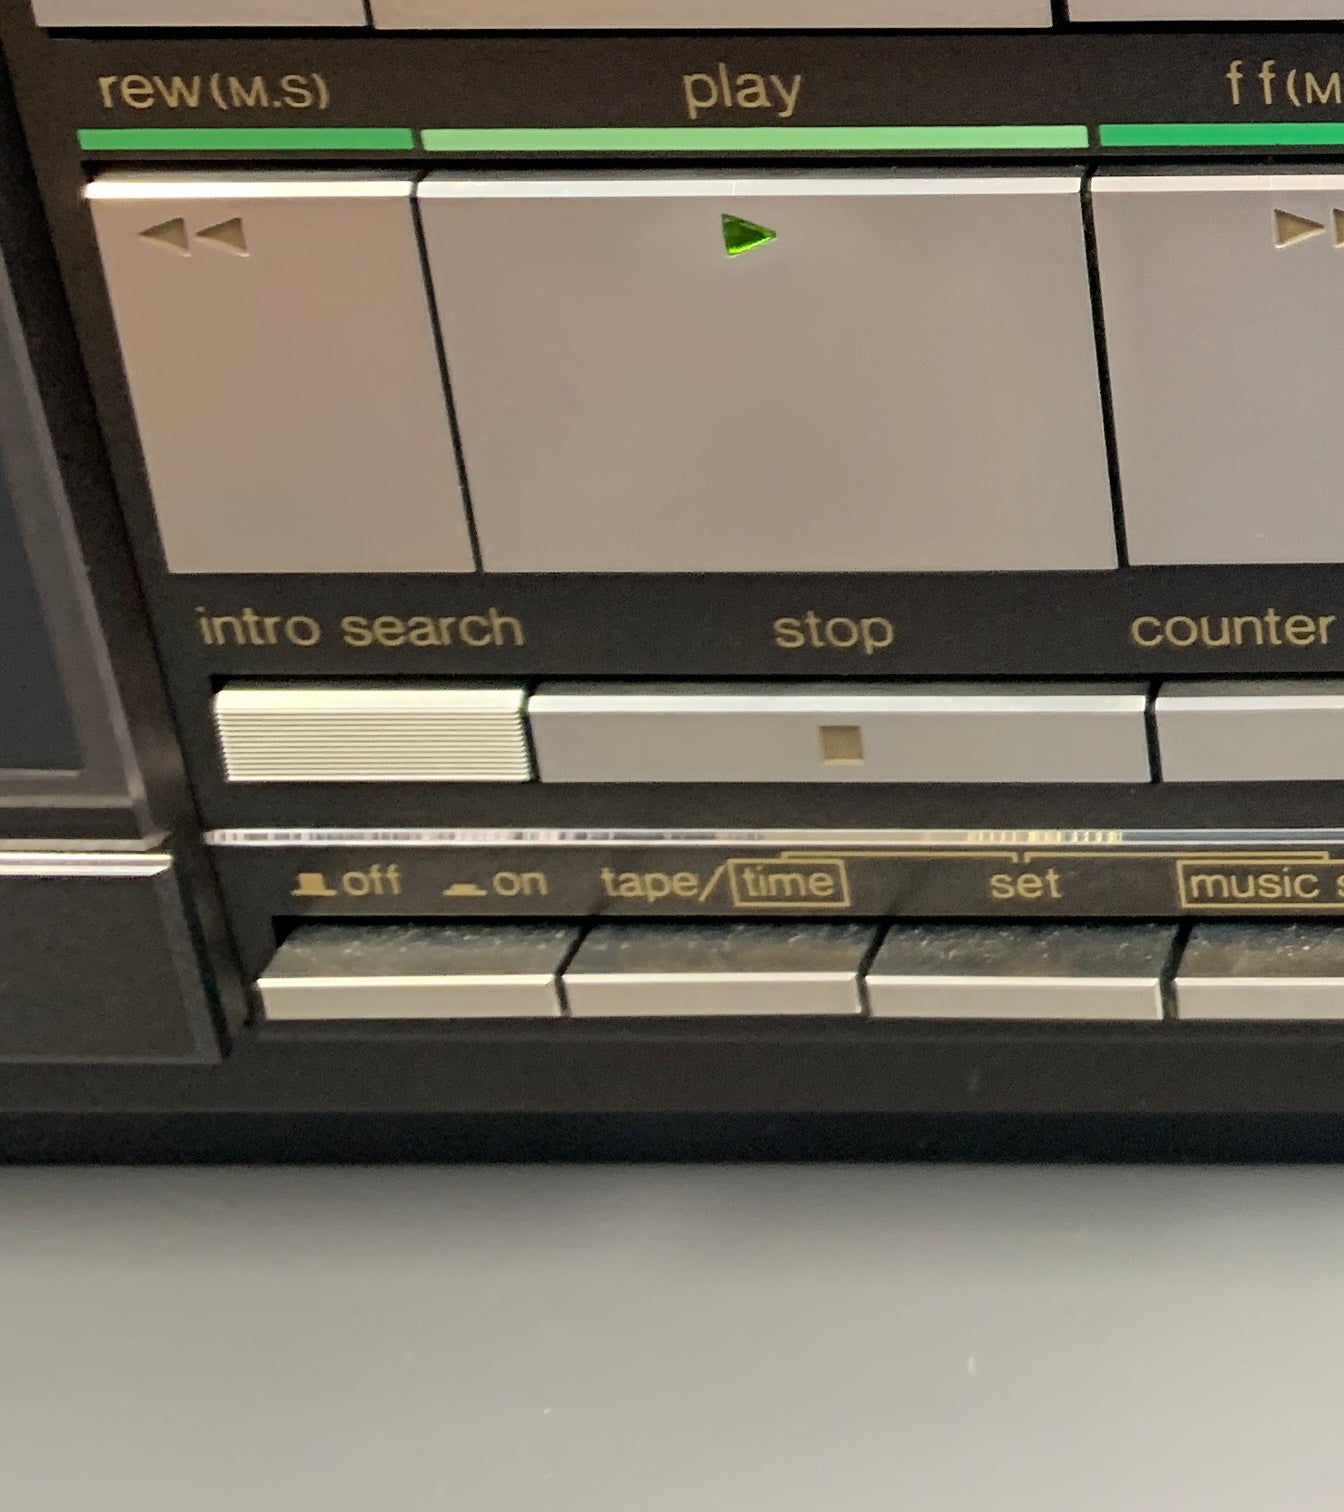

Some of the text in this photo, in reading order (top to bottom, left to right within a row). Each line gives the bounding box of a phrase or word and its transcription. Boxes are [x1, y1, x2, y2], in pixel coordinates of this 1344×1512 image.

[682, 62, 802, 120] play
[196, 607, 525, 647] intro search
[773, 610, 895, 656] stop
[1130, 608, 1338, 649] counter
[342, 864, 401, 897] off
[492, 871, 549, 897] on
[989, 865, 1063, 899] set
[1190, 866, 1320, 899] music
